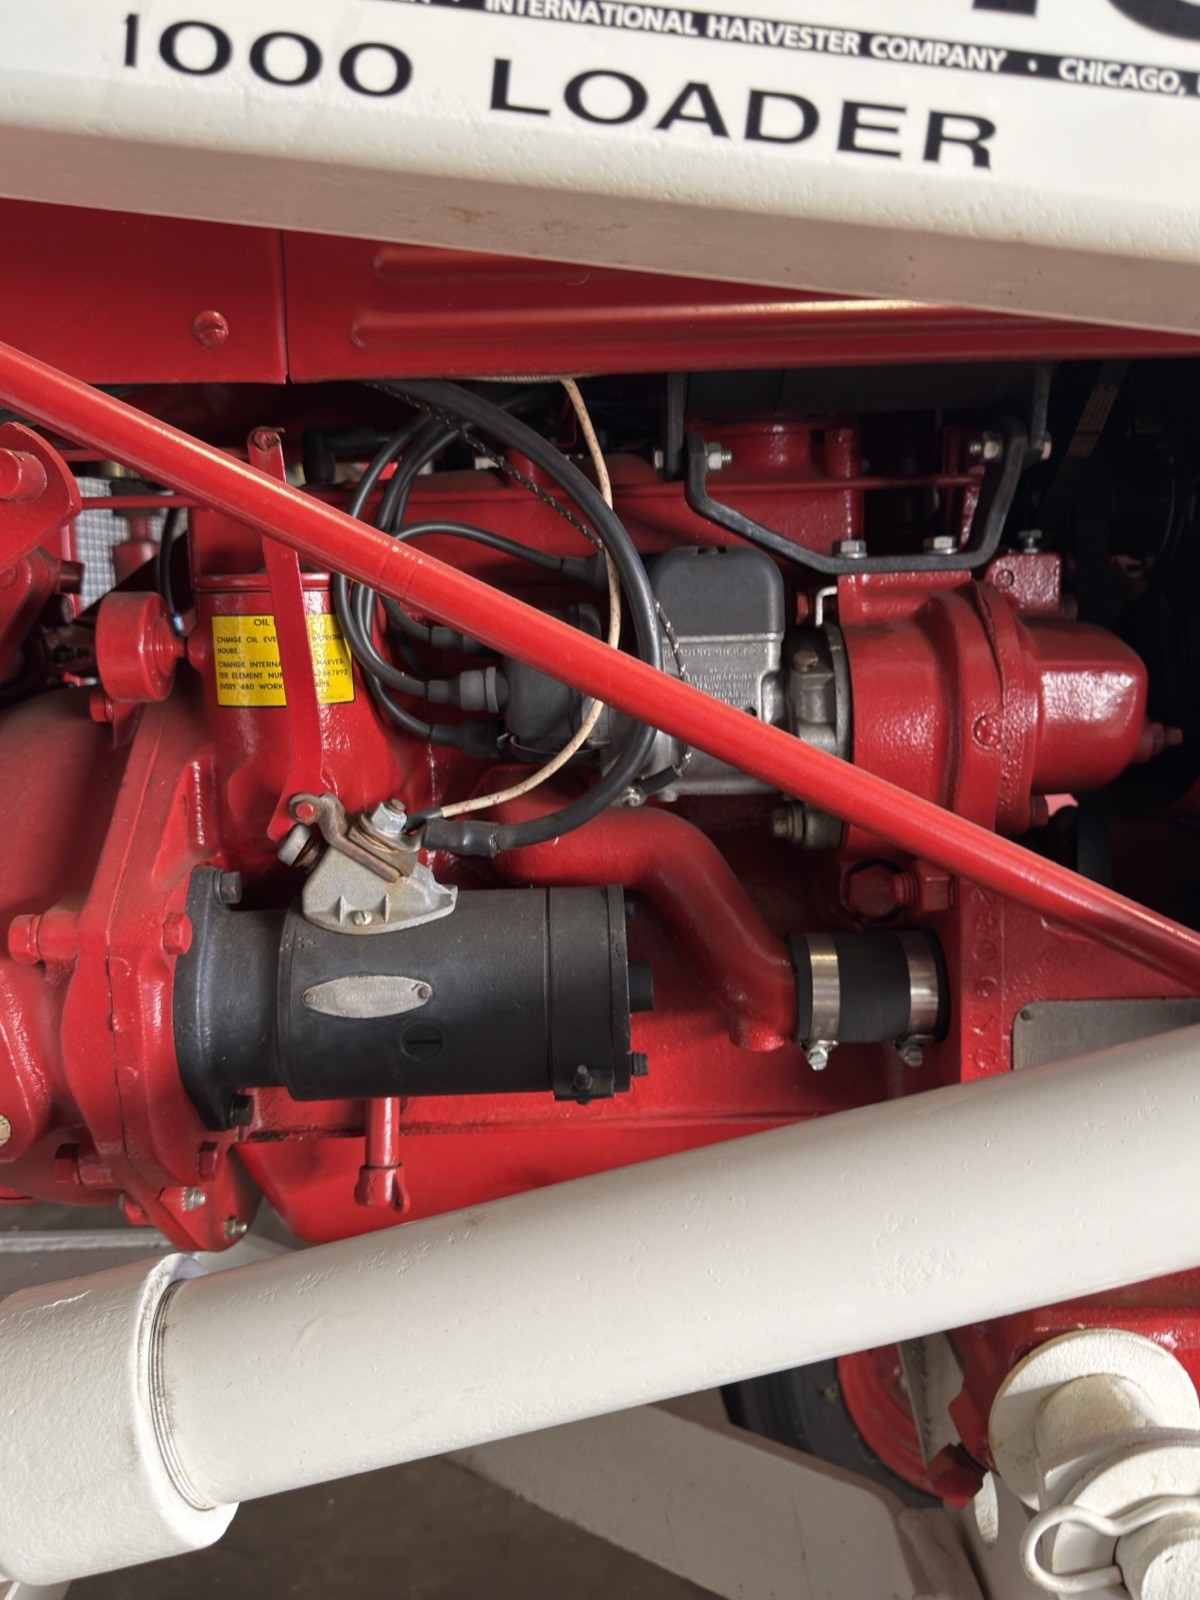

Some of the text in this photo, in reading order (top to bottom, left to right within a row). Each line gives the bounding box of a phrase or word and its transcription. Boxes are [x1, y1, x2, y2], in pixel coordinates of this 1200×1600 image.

[485, 0, 1186, 97] INTERNATIONAL HARVESTER COMPANY CHICAGO,
[124, 13, 998, 170] 1000 LOADER
[254, 618, 269, 627] OIL
[246, 636, 259, 644] OIL
[263, 636, 277, 644] EVE
[217, 647, 240, 655] HOURS.
[250, 661, 282, 669] INTERNA
[231, 672, 263, 680] ELEMENT
[220, 683, 237, 691] EVERY
